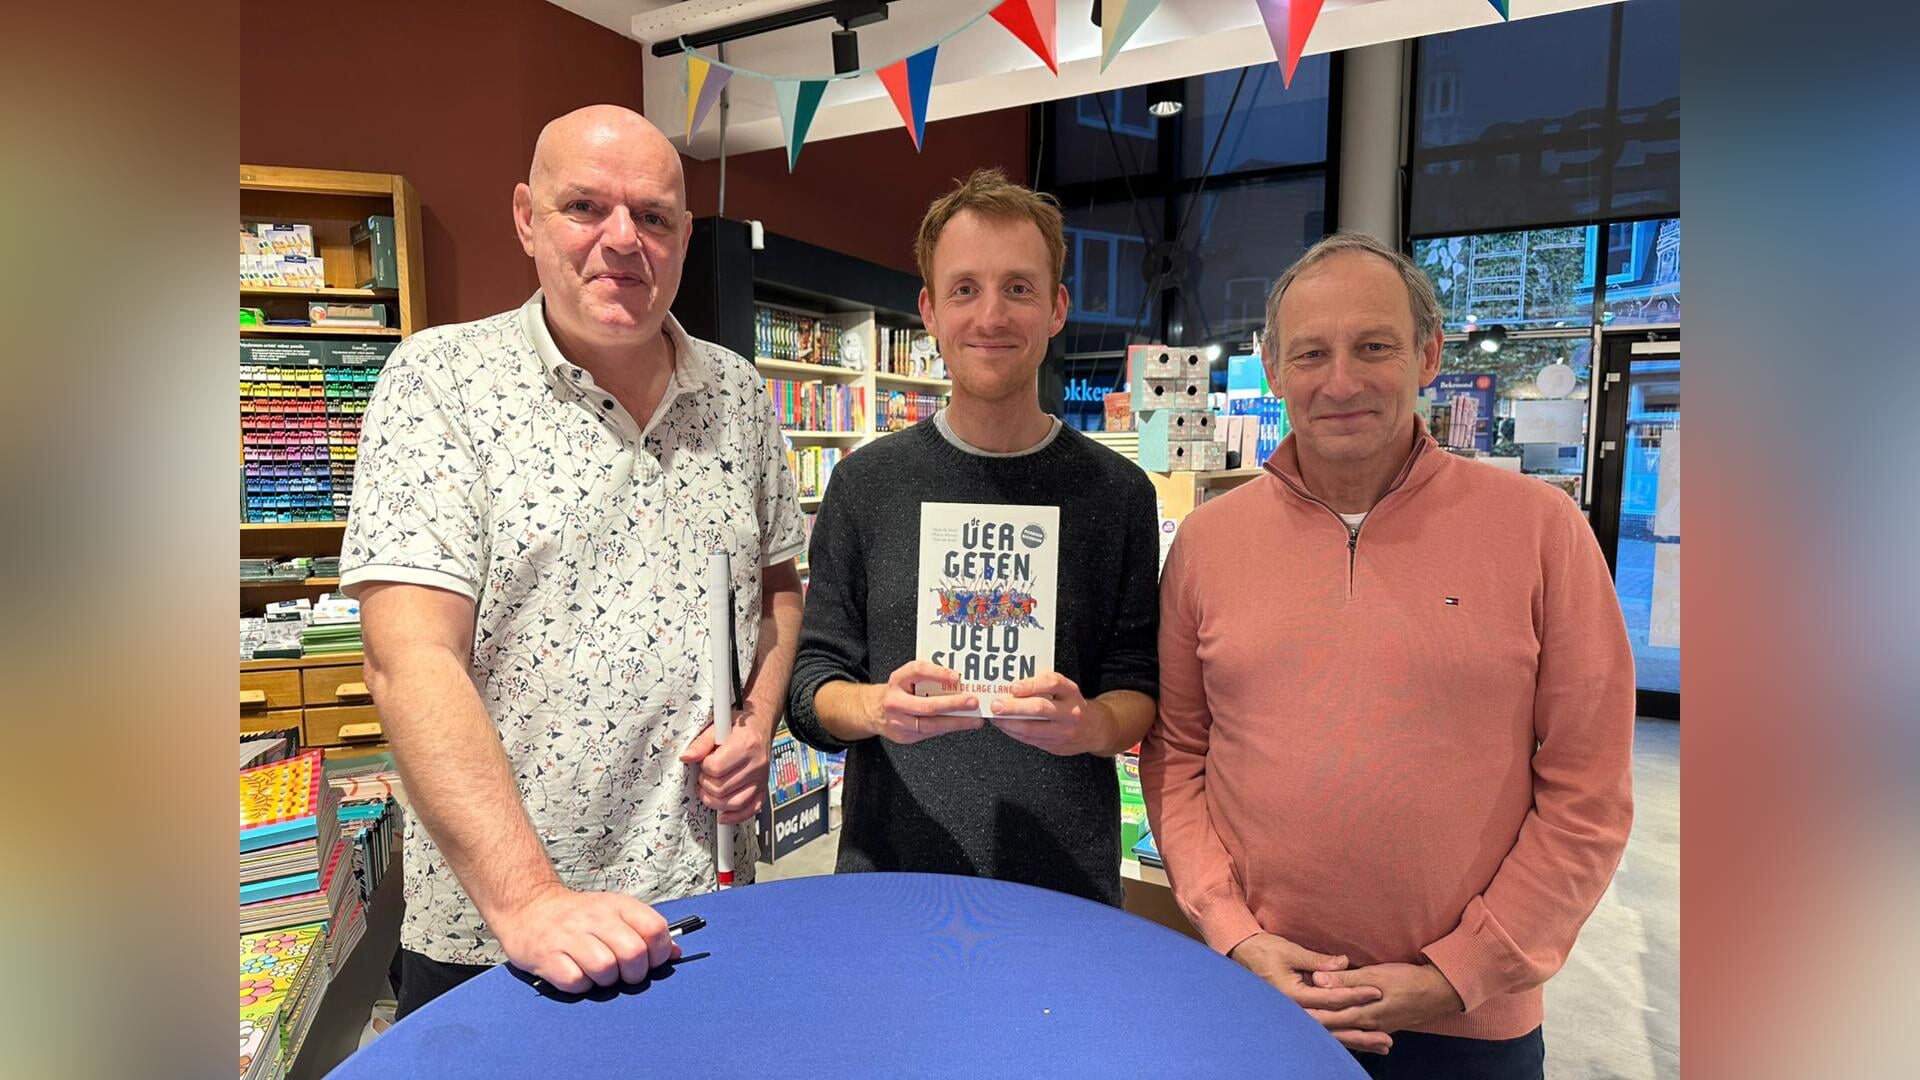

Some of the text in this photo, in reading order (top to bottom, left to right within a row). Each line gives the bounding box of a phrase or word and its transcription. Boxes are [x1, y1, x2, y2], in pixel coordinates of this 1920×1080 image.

[971, 516, 980, 527] de
[945, 550, 1030, 581] GETEN
[960, 683, 970, 692] DE
[972, 683, 992, 693] LAGE
[775, 815, 798, 842] DOG
[799, 803, 820, 830] MAN
